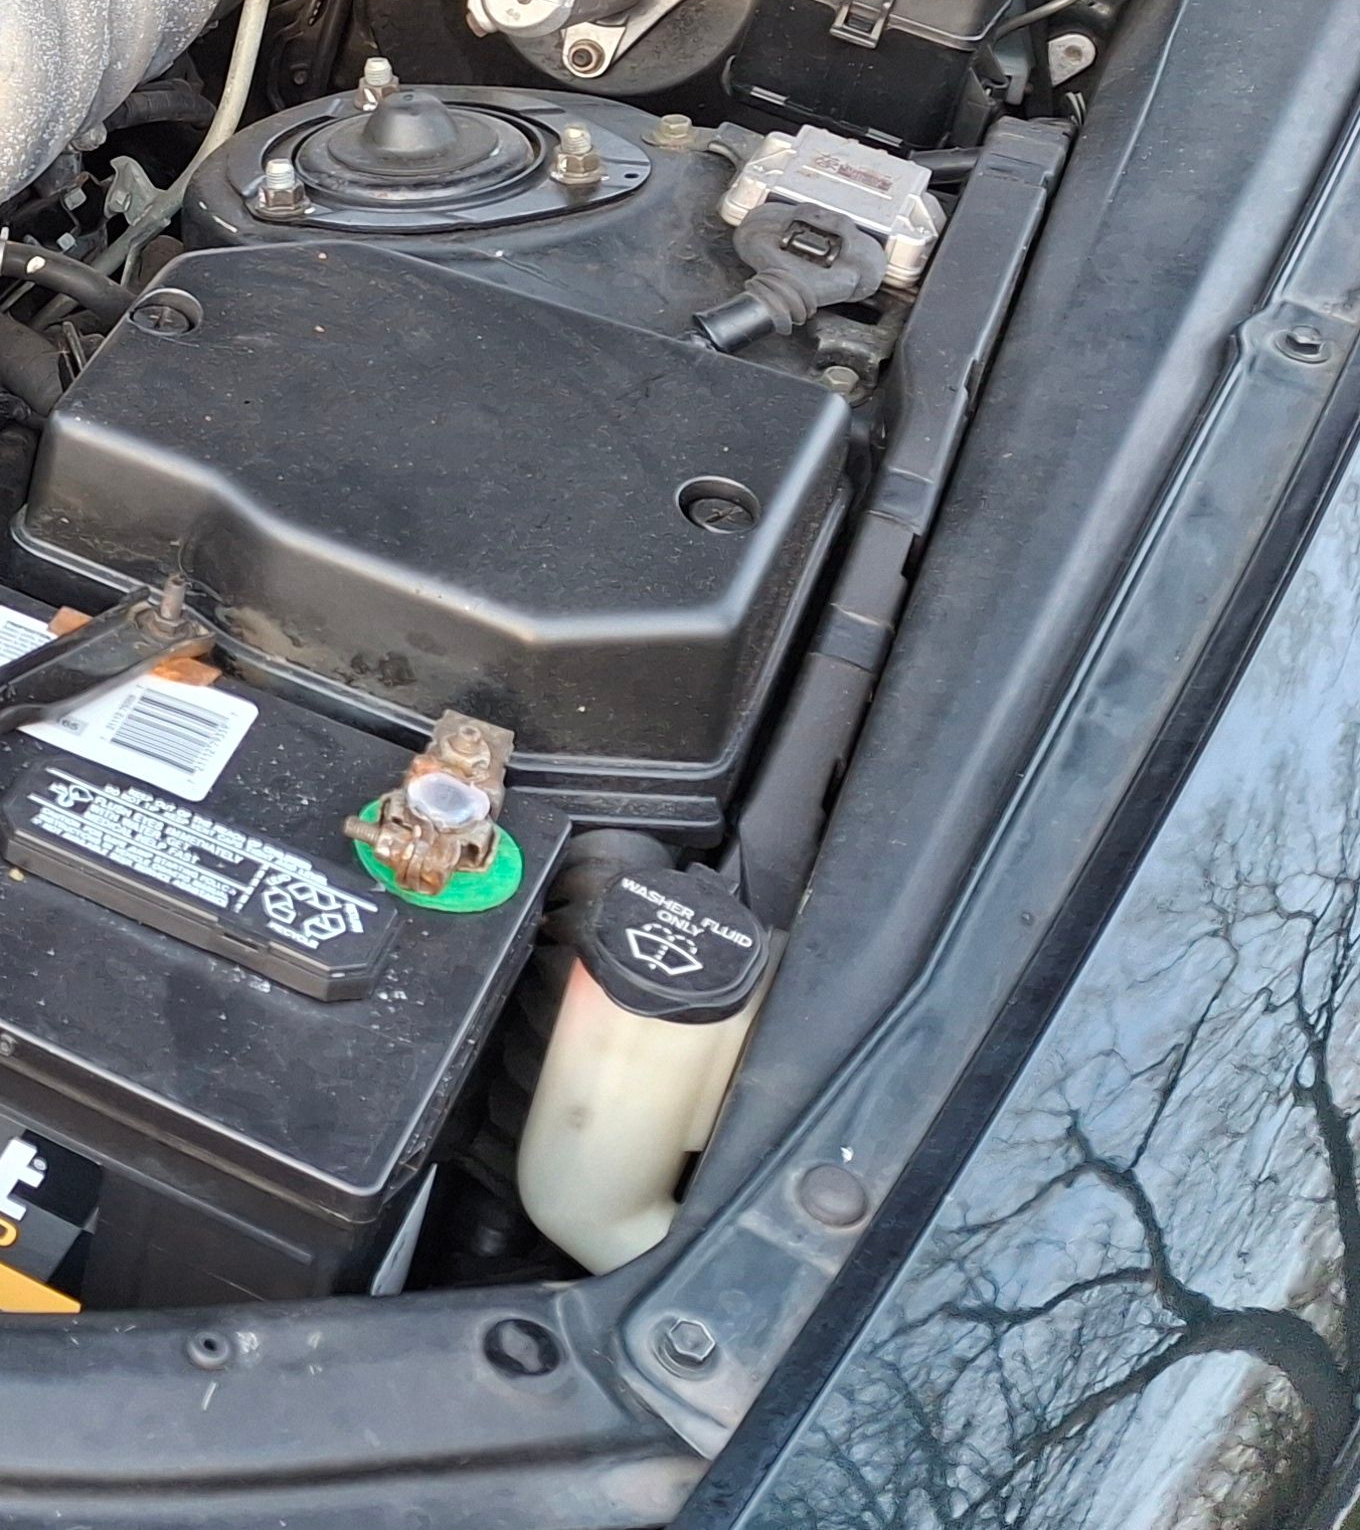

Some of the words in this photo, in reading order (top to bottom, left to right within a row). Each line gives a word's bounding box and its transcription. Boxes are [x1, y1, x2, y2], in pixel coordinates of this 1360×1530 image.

[84, 811, 133, 838] MEDICAL
[135, 833, 168, 849] HELP
[169, 847, 200, 864] FAST
[89, 804, 120, 822] WITH
[166, 836, 191, 851] GET
[95, 796, 132, 817] FLUSH
[133, 812, 164, 830] EYES
[165, 826, 244, 864] IMMEDIATELY
[621, 877, 695, 920] WASHER
[701, 917, 753, 948] FLUID
[657, 909, 705, 937] ONLY
